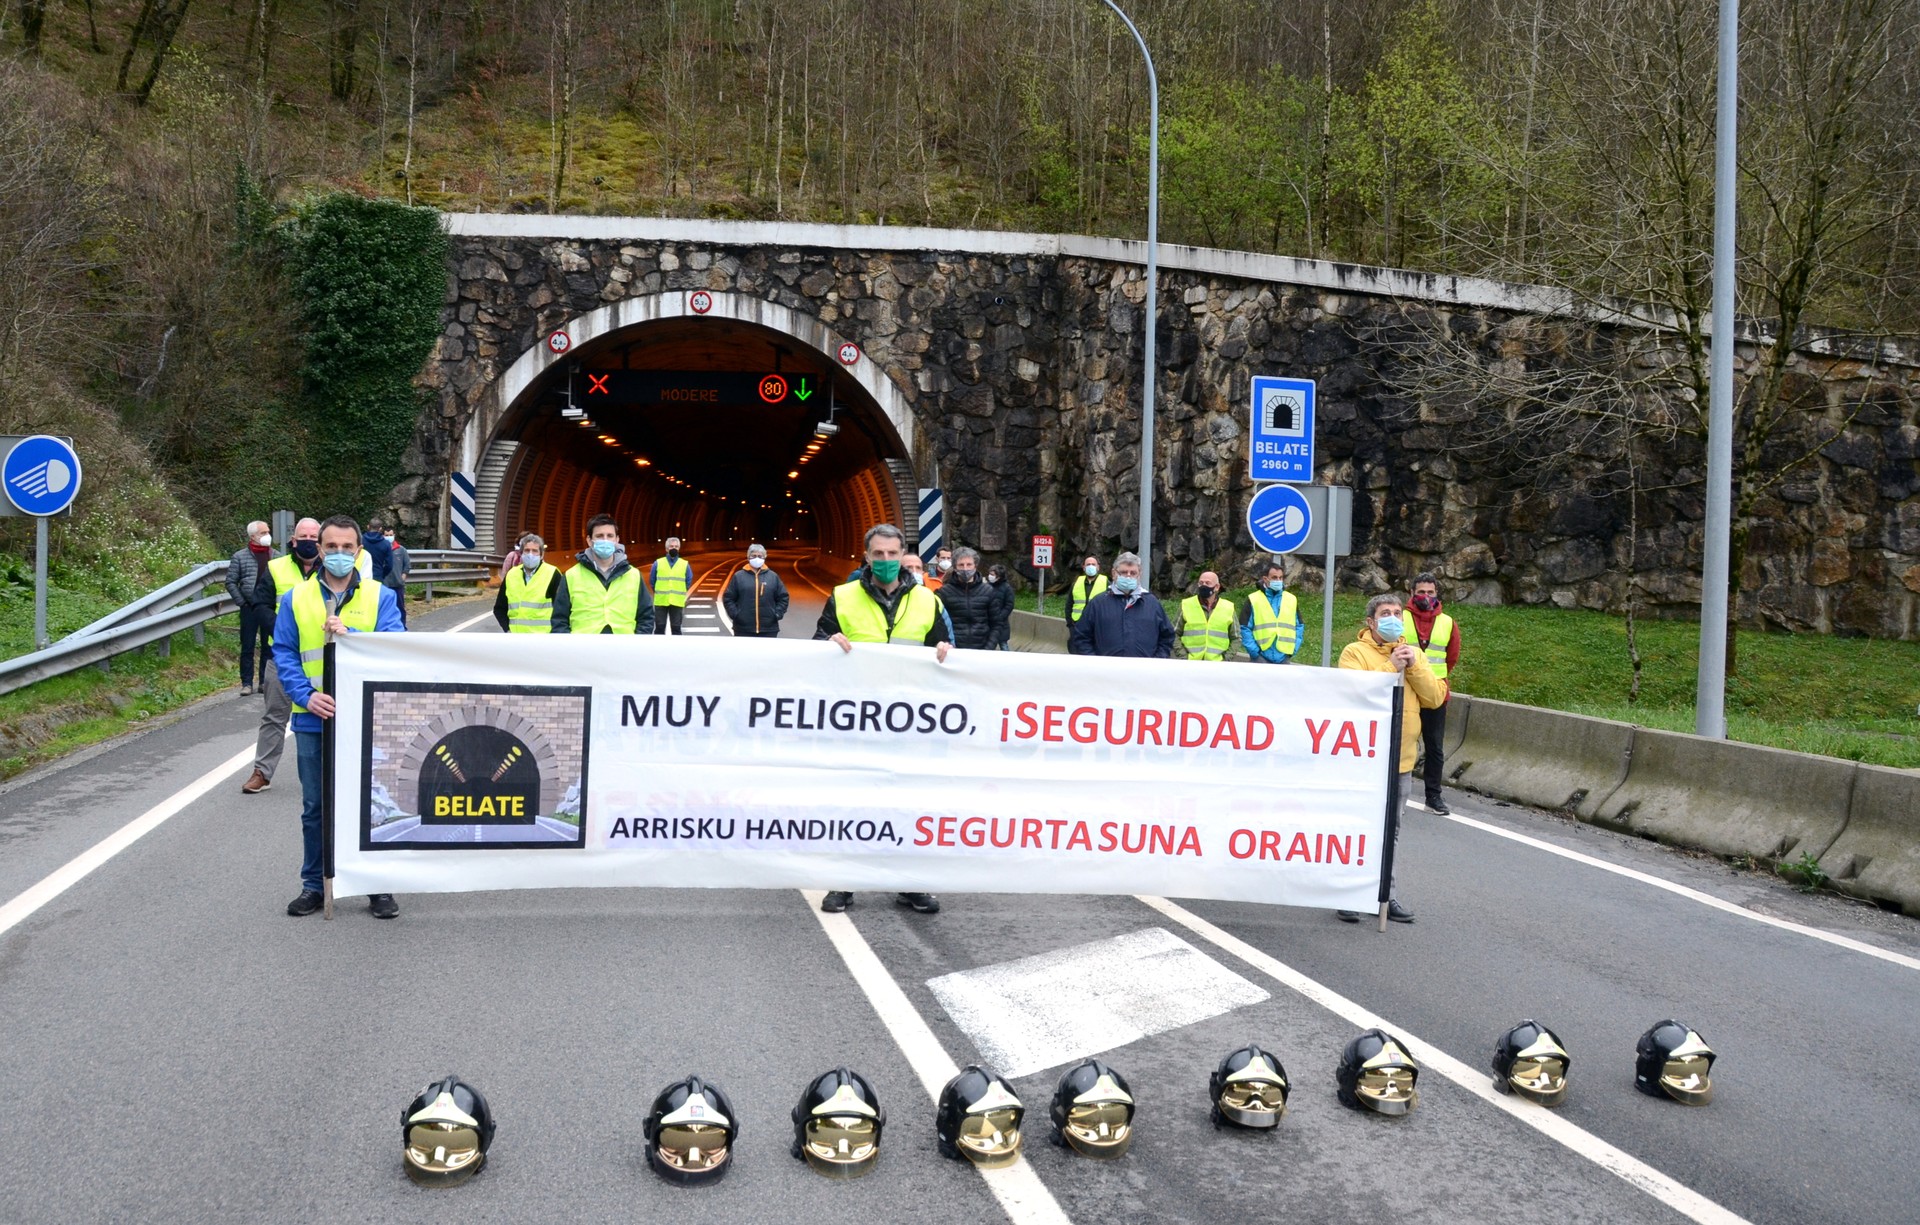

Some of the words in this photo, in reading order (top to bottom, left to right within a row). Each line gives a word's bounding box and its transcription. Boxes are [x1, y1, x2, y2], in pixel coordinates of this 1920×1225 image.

[765, 382, 782, 396] 80
[1255, 441, 1309, 456] BELATE
[1261, 459, 1289, 470] 2960
[1293, 463, 1303, 471] m
[1037, 555, 1048, 564] 31
[622, 695, 721, 727] MUY
[748, 697, 977, 737] PELIGROSO,
[1001, 701, 1275, 751] ¡SEGURIDAD
[1305, 719, 1378, 758] YA!
[434, 795, 525, 817] BELATE
[610, 817, 735, 840] ARRISKU
[745, 819, 904, 846] HANDIKOA,
[913, 816, 1203, 857] SEGURTASUNA
[1229, 829, 1367, 867] ORAIN!
